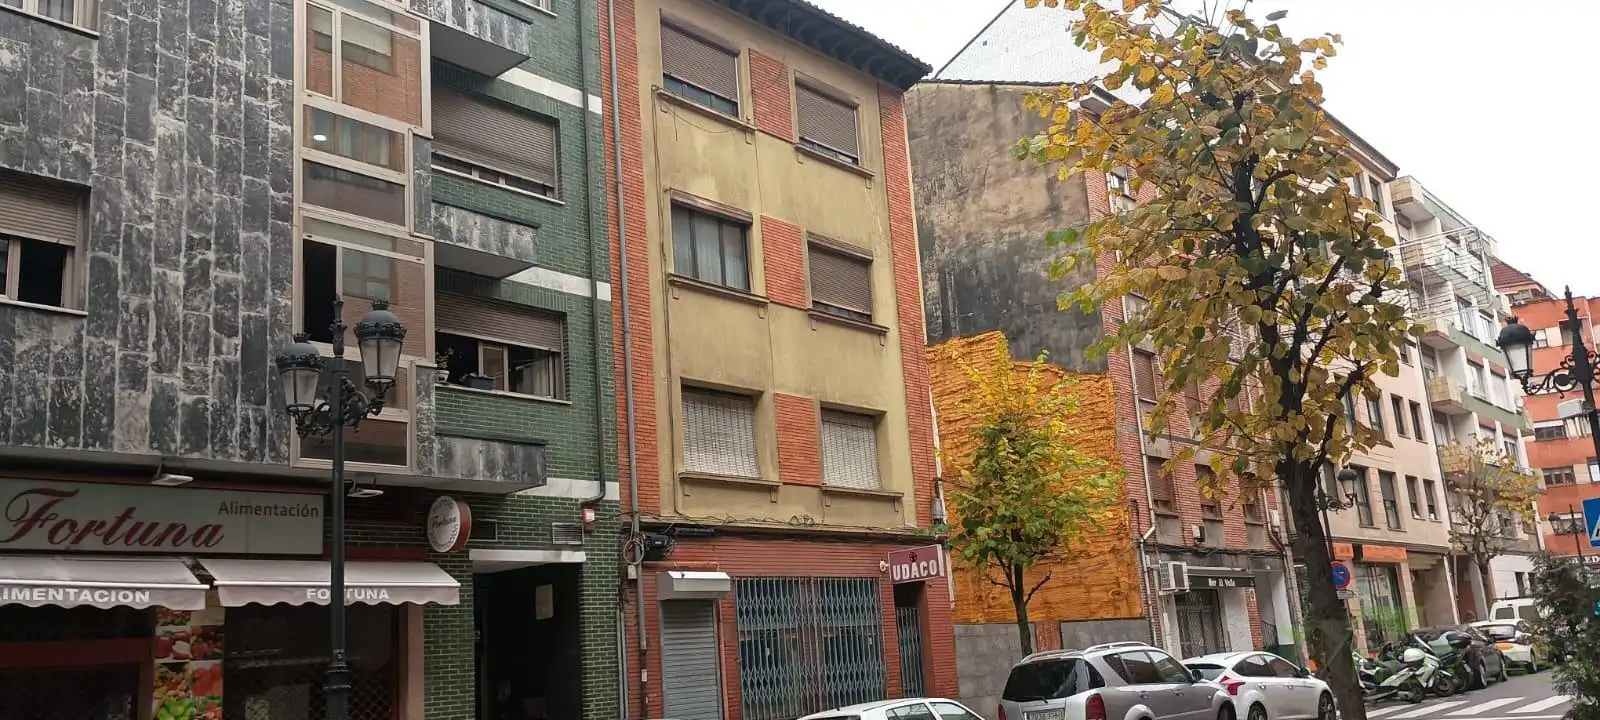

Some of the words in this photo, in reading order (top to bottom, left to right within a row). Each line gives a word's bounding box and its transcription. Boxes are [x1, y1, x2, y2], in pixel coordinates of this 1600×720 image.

[0, 487, 224, 548] Fortuna
[217, 501, 319, 518] Alimentación
[892, 560, 938, 580] UDACO
[0, 587, 150, 602] IMENTACION
[306, 588, 389, 599] FOTUNA
